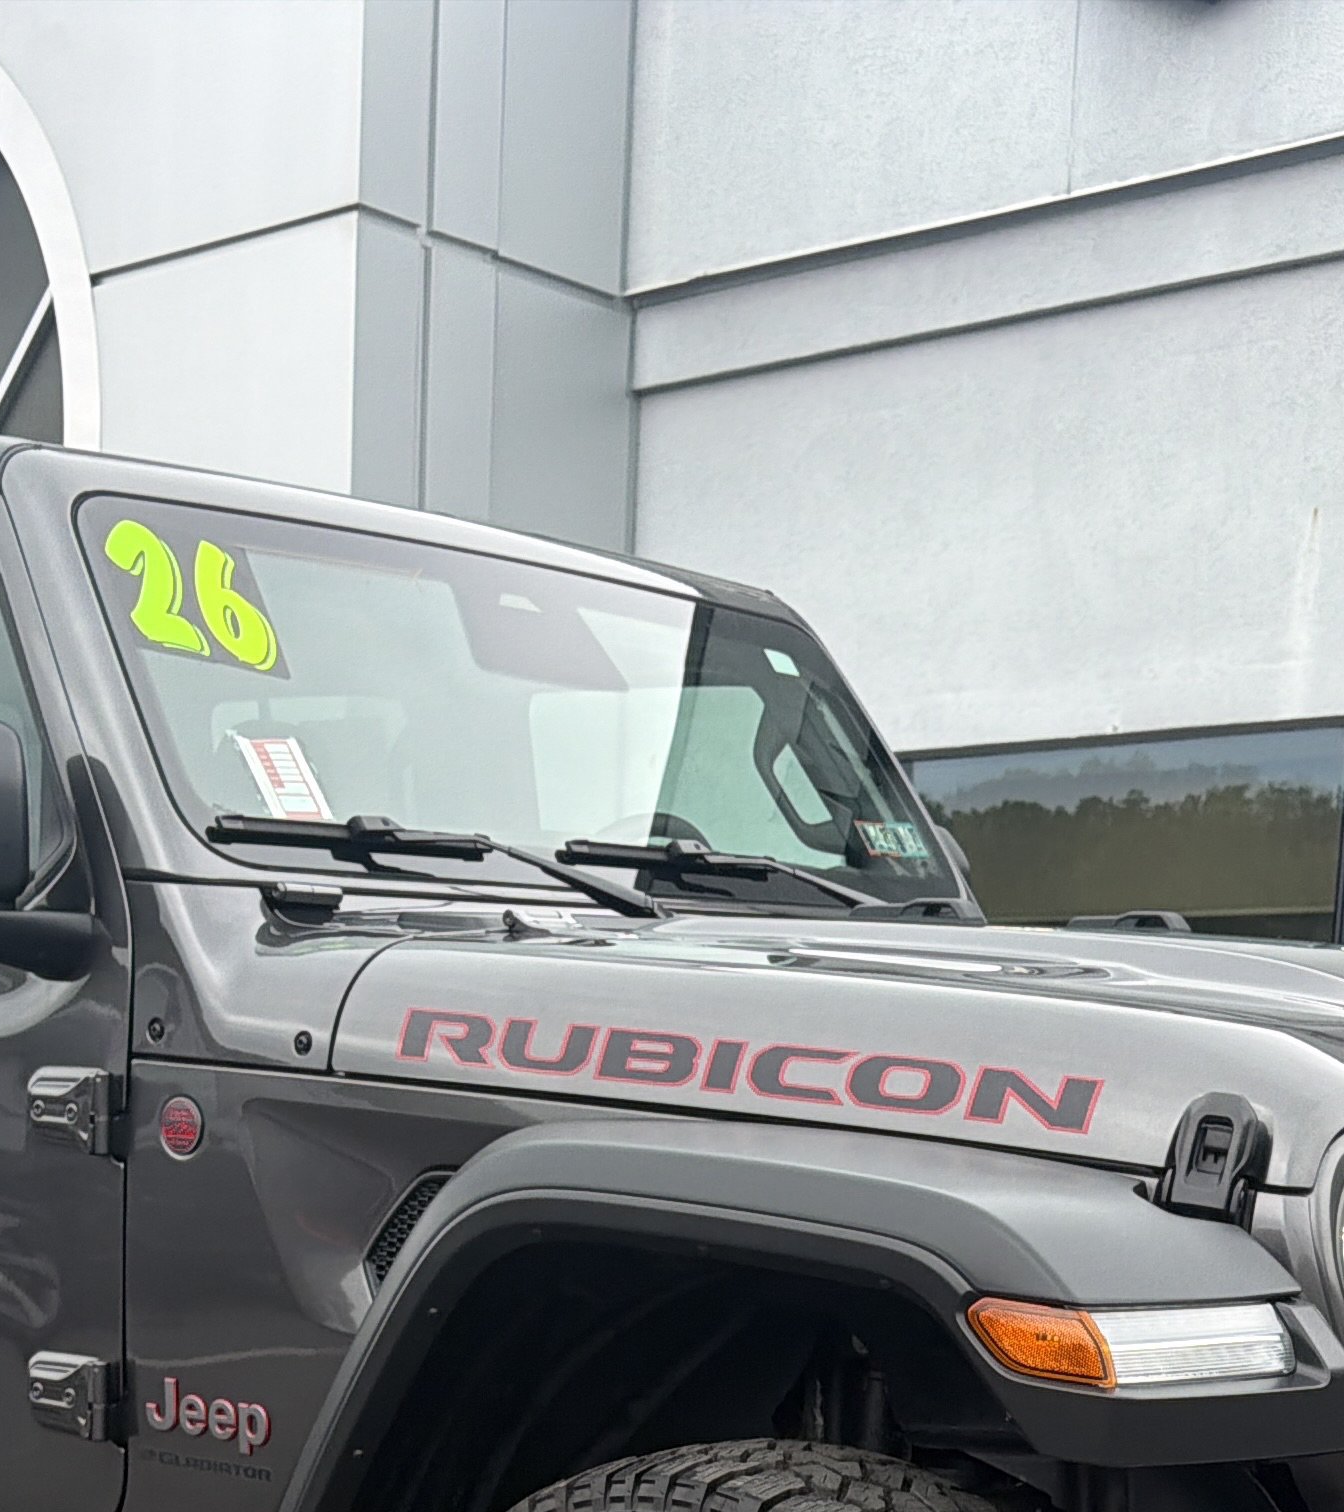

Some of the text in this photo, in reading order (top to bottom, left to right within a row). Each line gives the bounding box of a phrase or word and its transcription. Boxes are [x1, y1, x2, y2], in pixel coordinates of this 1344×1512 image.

[104, 519, 277, 672] 26
[396, 1007, 1105, 1135] RUBICON
[145, 1376, 272, 1456] Jeep
[158, 1450, 273, 1483] GLADIATOR
